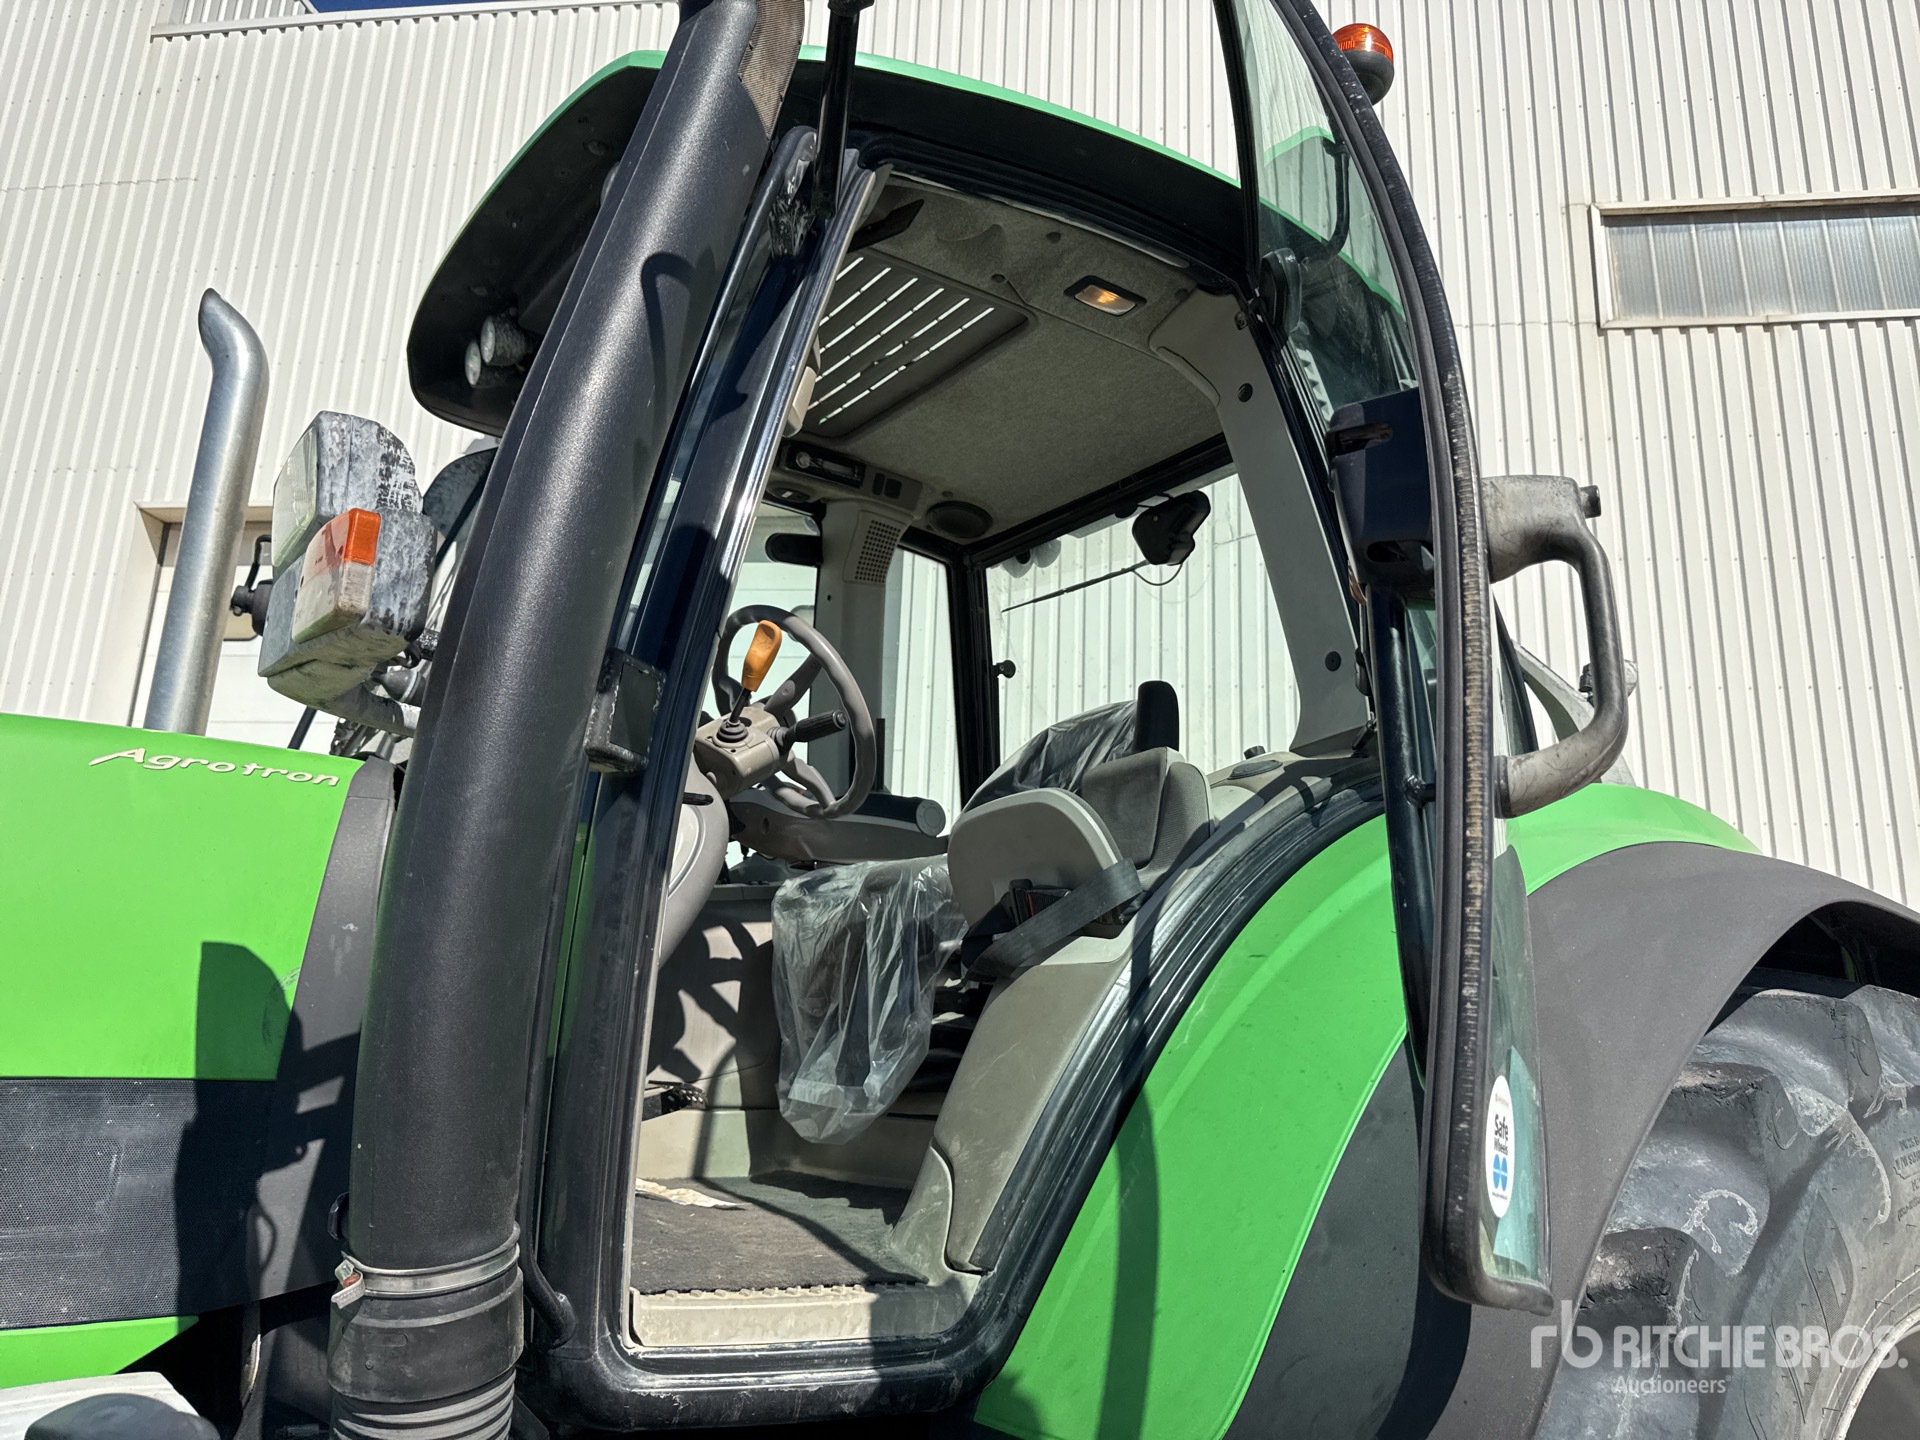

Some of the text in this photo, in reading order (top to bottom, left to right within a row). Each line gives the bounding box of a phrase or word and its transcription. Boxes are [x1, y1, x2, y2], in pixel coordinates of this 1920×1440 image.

[89, 748, 340, 787] Agrotron
[1494, 1113, 1509, 1142] Safe
[1493, 1137, 1509, 1156] Wheels
